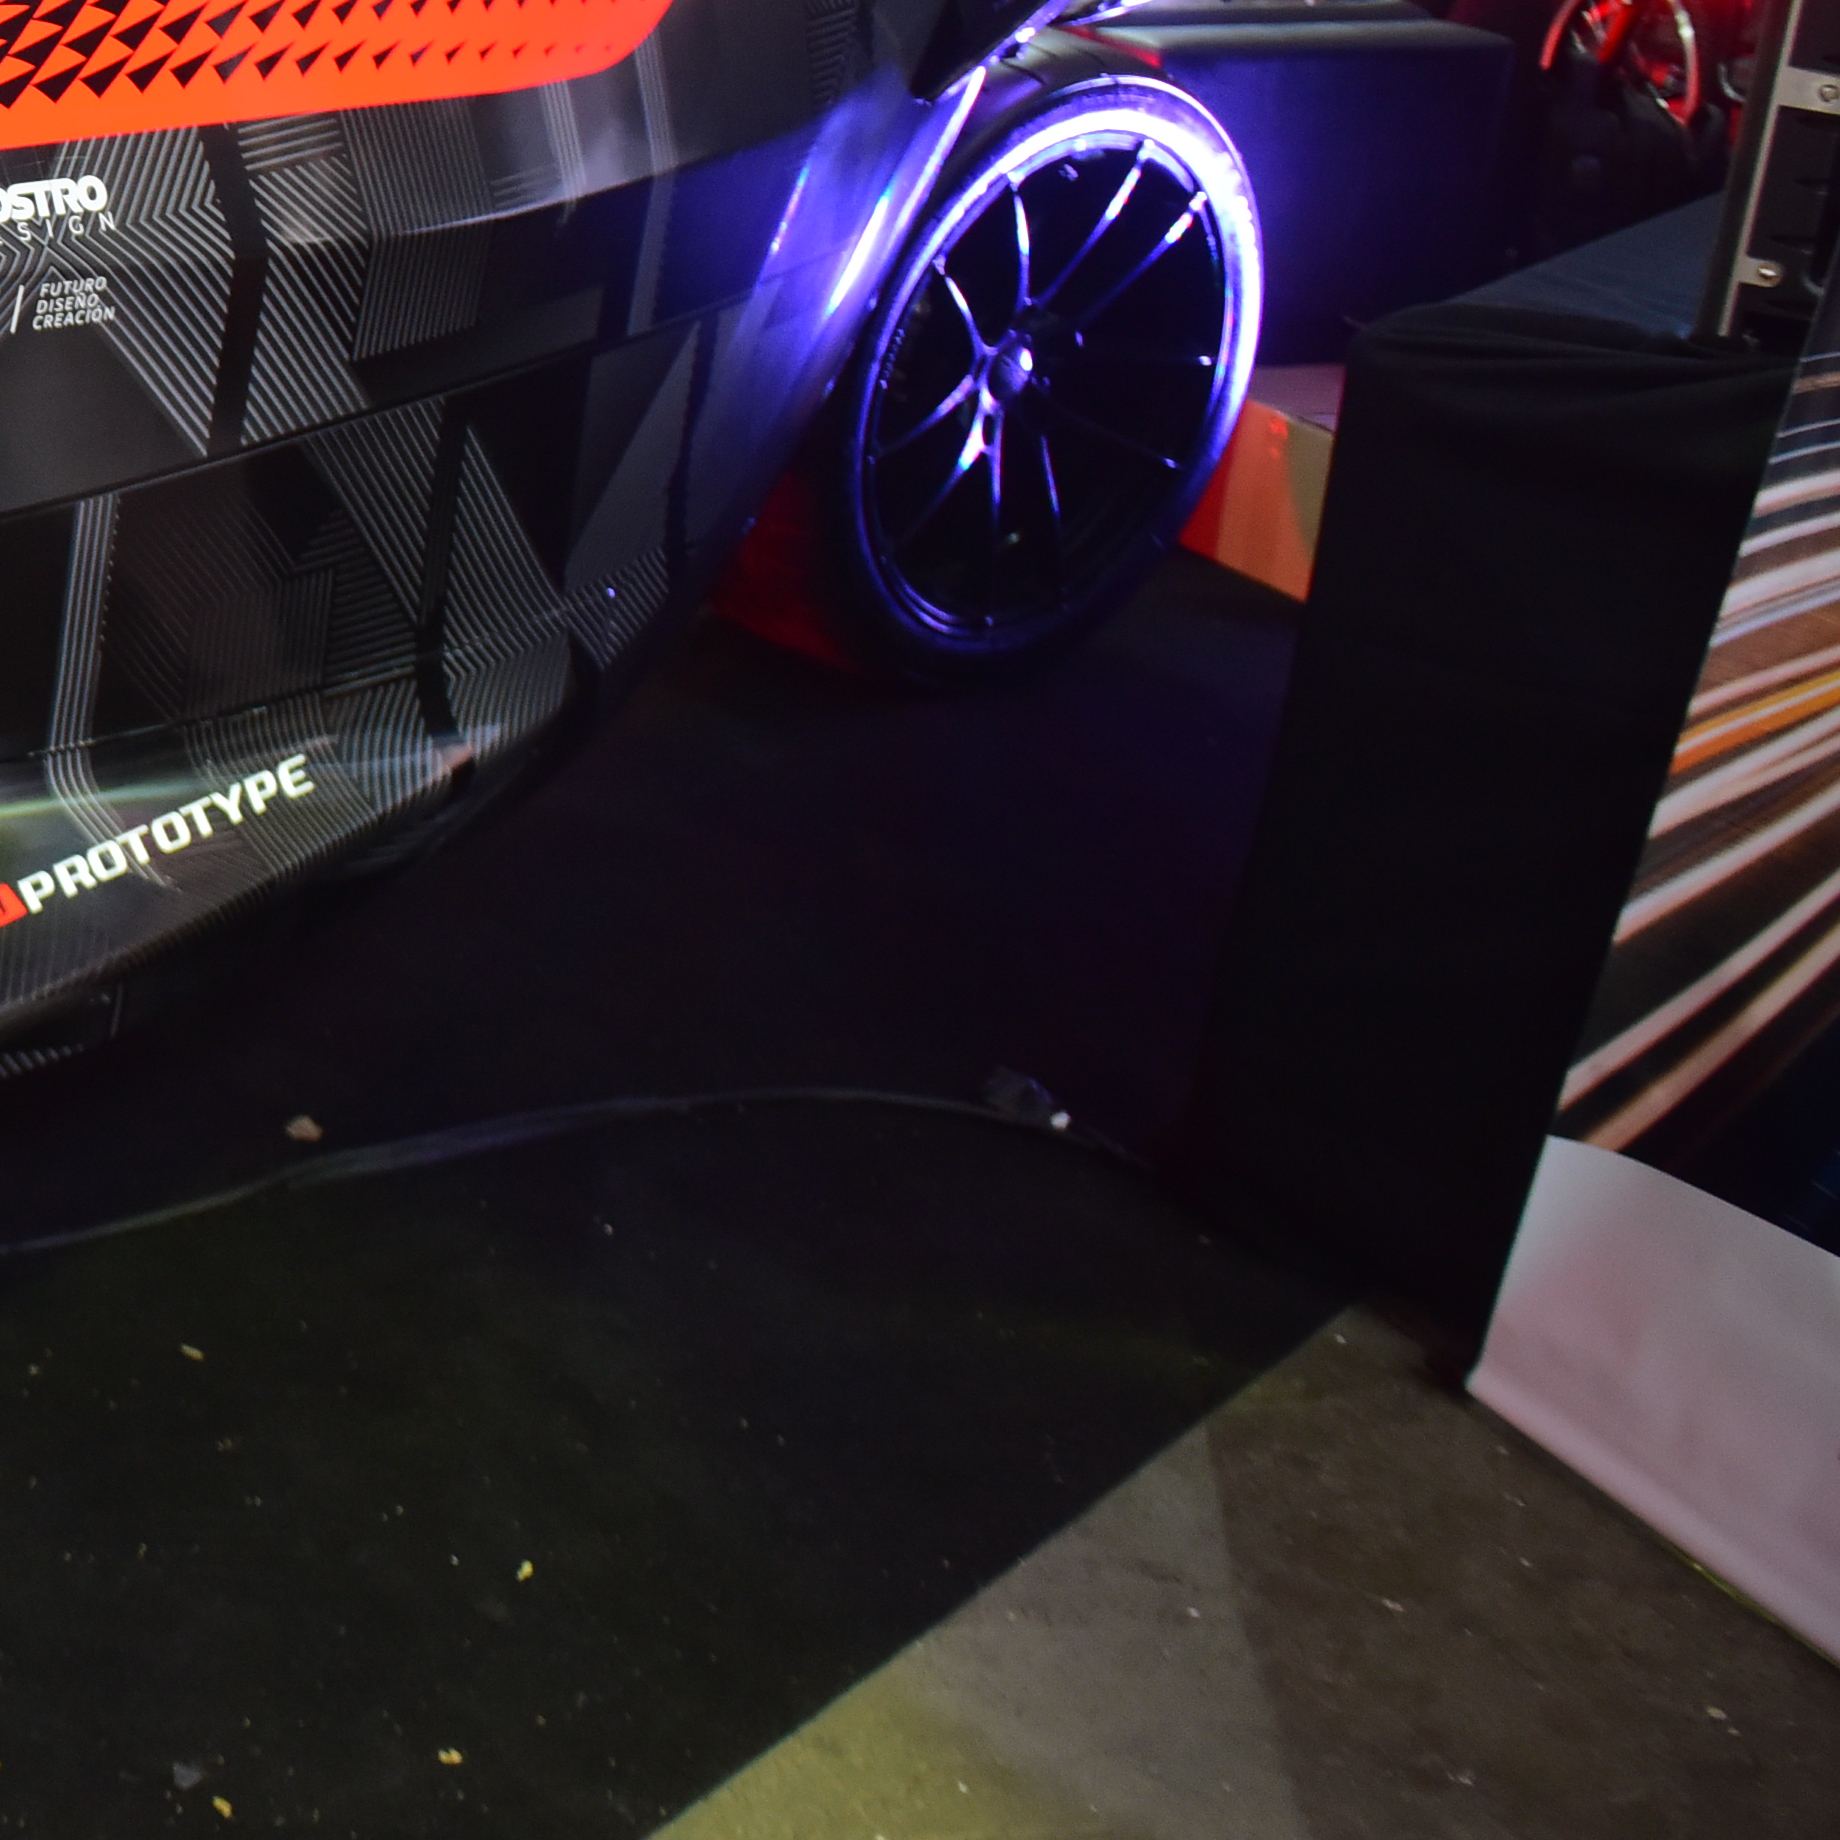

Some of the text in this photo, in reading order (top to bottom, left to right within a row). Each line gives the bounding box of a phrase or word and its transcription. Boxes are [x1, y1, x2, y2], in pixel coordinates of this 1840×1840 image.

[39, 275, 108, 298] FUTURO
[35, 292, 100, 315] DISEÑO
[31, 305, 116, 331] CREACIÓN
[16, 752, 317, 915] PROTOTYPE
